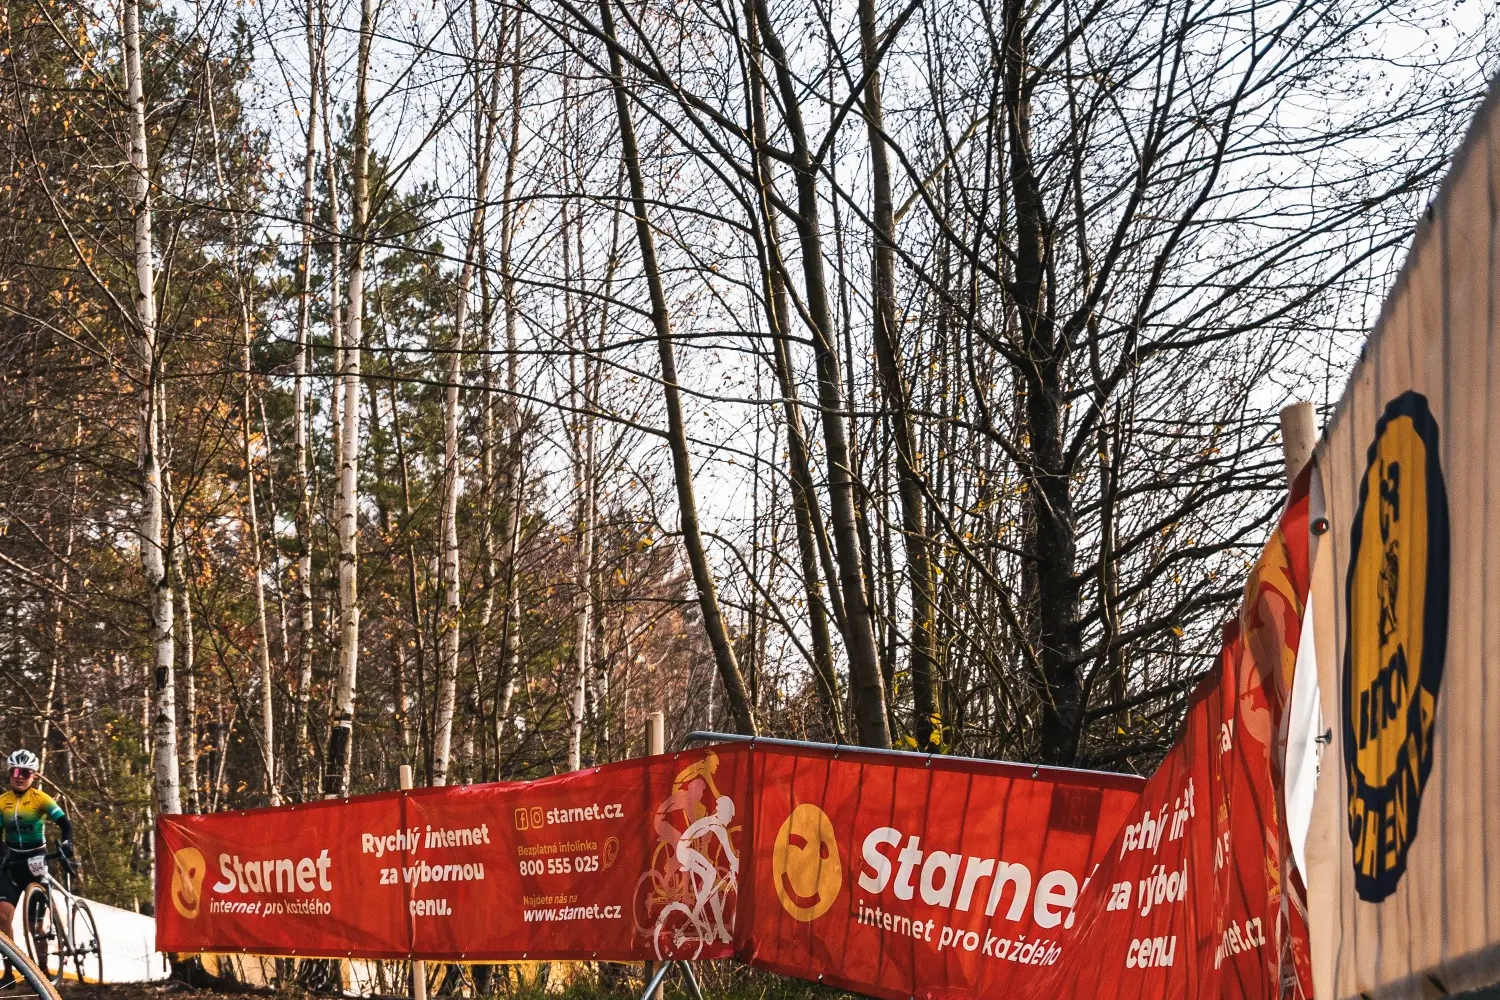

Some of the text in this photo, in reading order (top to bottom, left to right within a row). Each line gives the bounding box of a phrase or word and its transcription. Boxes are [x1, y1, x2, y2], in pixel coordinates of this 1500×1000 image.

[546, 803, 624, 825] starnet.cz
[361, 823, 491, 857] Rychlý internet
[518, 840, 598, 857] Bezplatná infolinka
[213, 849, 332, 893] Starnet
[380, 860, 485, 888] za výbornou
[519, 855, 599, 876] 800 555 025
[523, 893, 578, 908] Najdete nás na
[1106, 880, 1132, 912] za
[210, 898, 331, 917] internet pro každého
[409, 899, 452, 916] cenu.
[523, 903, 621, 922] www.starnet.cz
[856, 898, 1062, 967] internet pro každého
